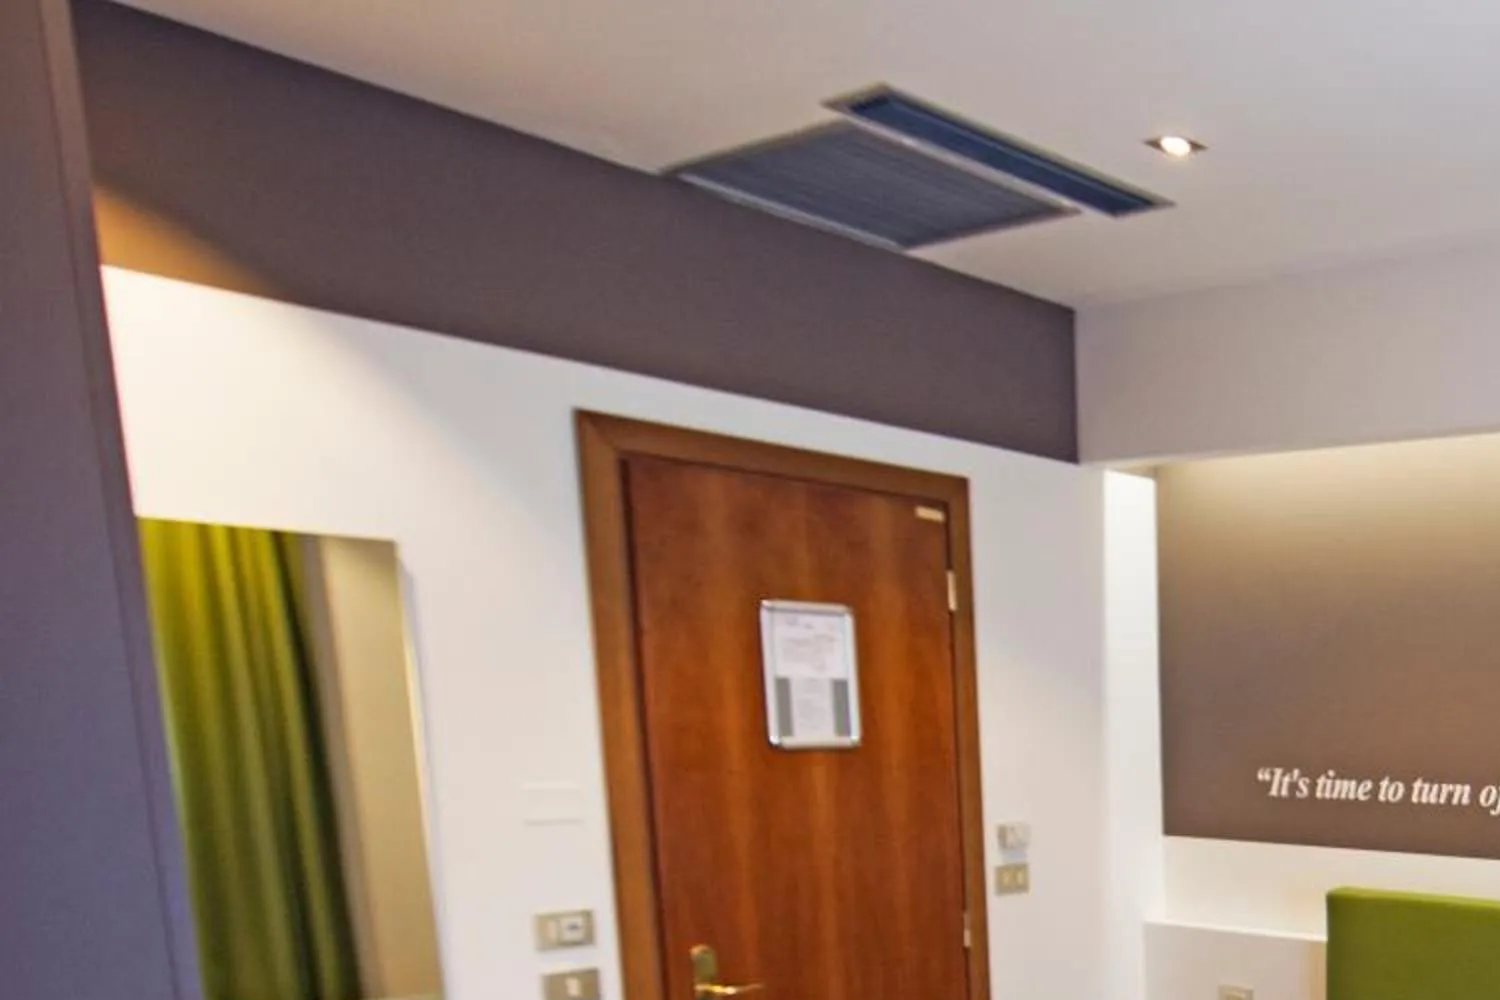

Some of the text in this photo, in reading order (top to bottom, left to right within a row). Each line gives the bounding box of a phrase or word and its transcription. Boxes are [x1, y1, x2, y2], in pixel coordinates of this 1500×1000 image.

[1314, 770, 1374, 802] time
[1378, 777, 1405, 803] to
[1411, 778, 1472, 806] turn
